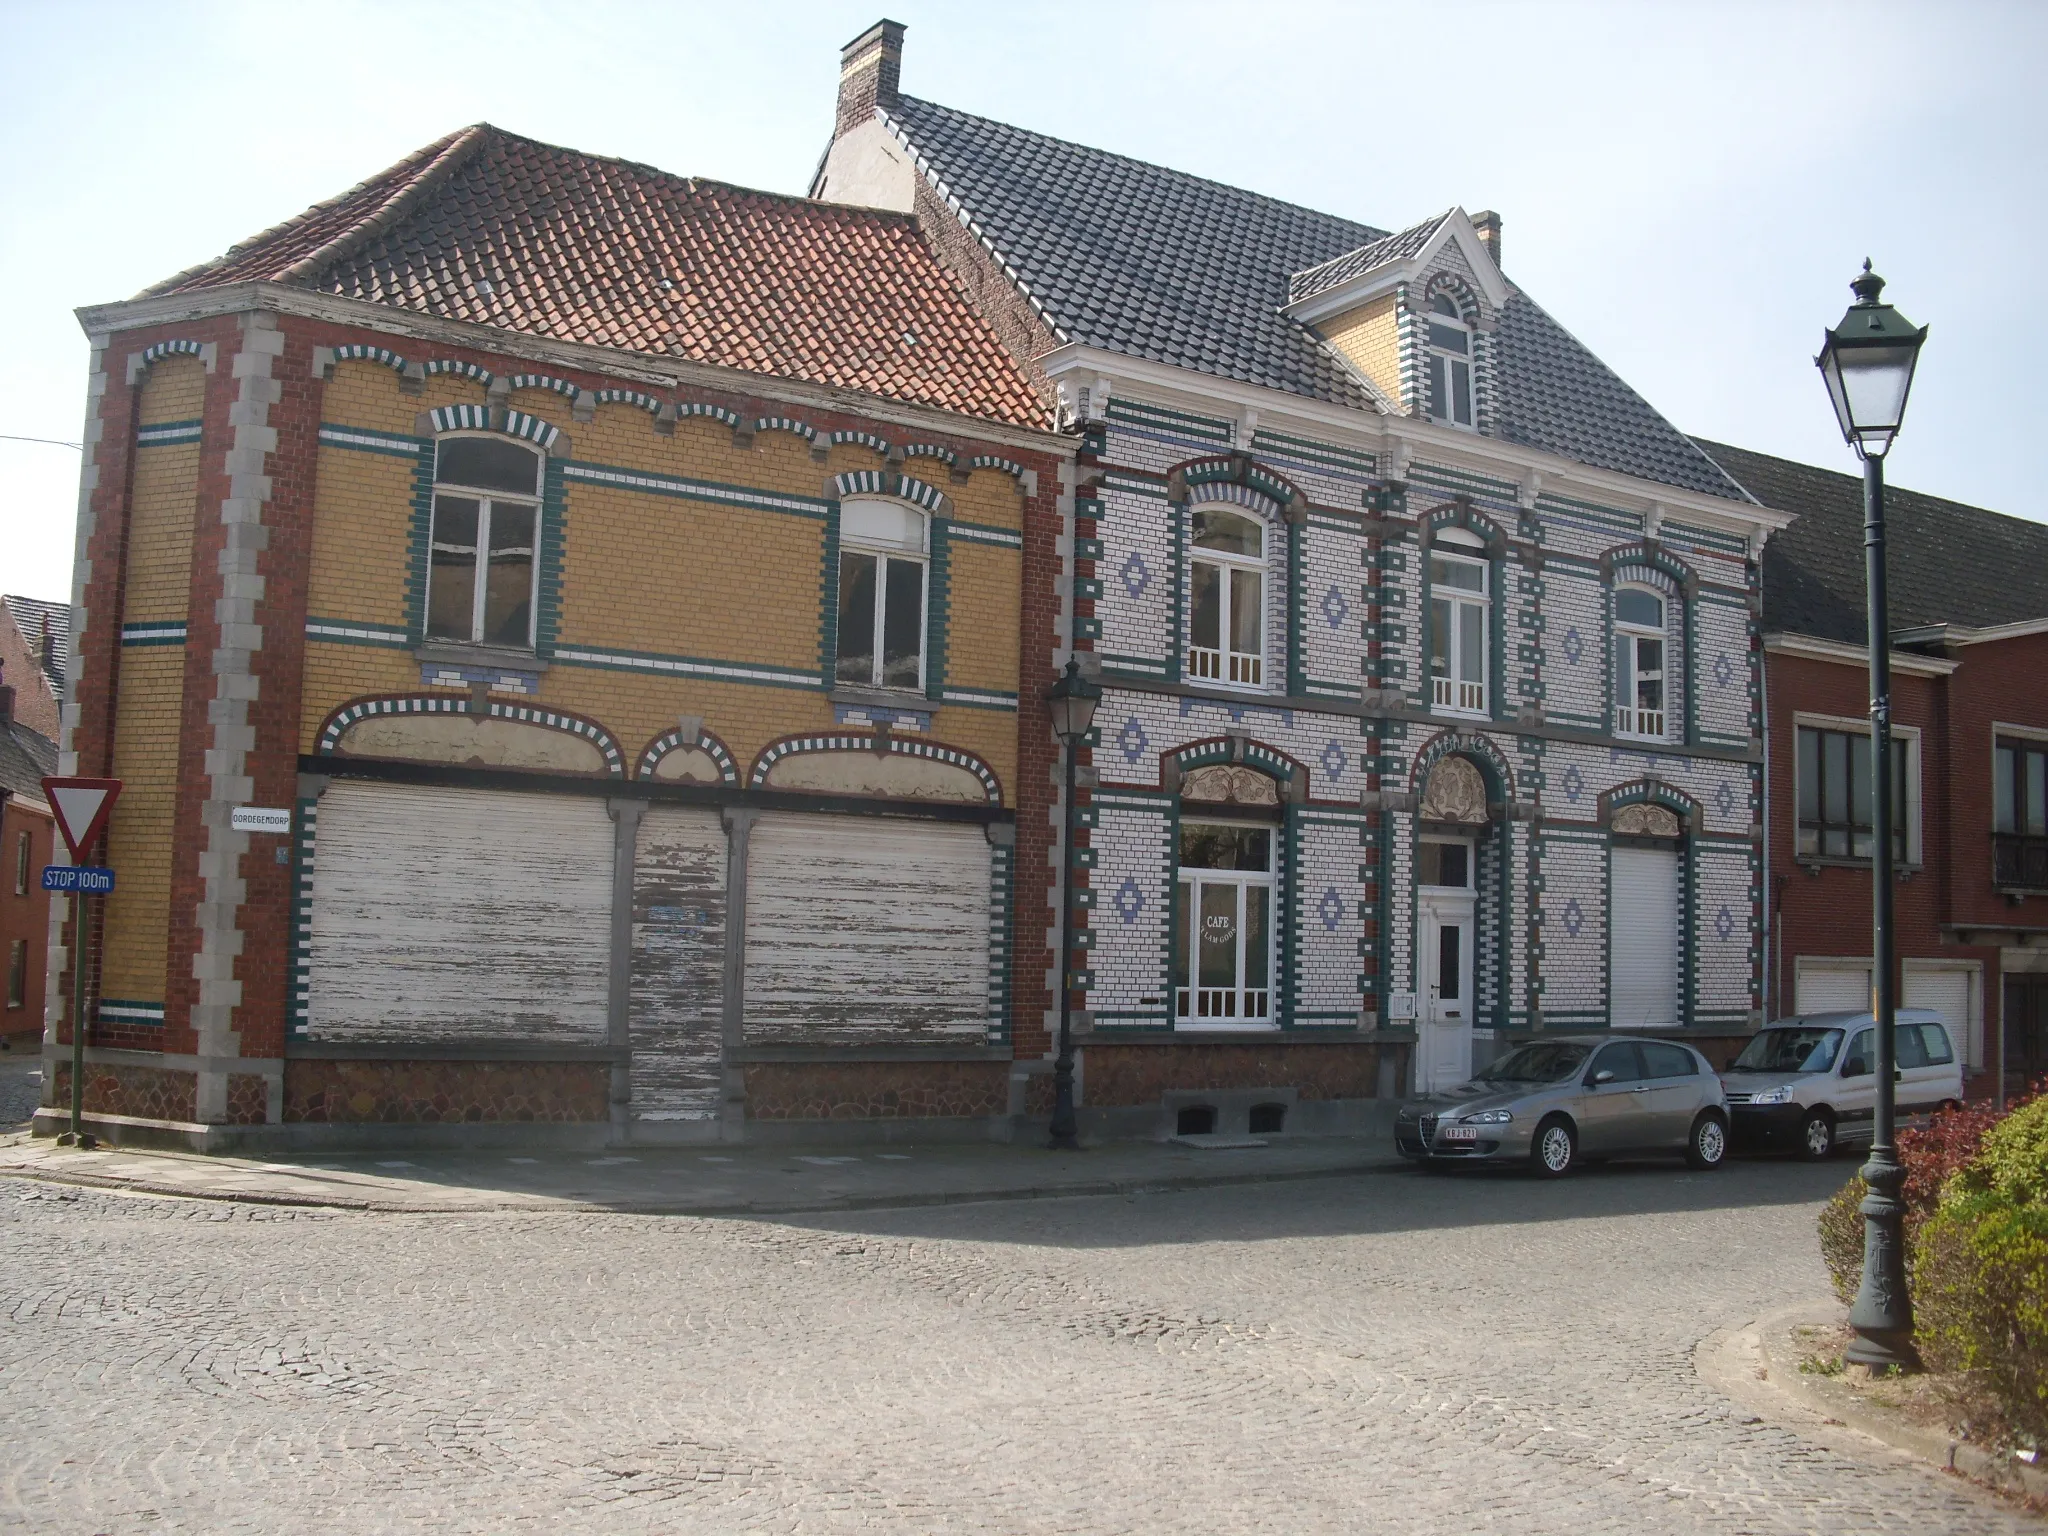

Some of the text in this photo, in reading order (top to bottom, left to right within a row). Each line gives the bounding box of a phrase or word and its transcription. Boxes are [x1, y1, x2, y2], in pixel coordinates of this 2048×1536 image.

[233, 815, 289, 825] OORDEGEMDORP
[45, 870, 109, 888] STOP 100m
[1207, 916, 1229, 928] CAFE
